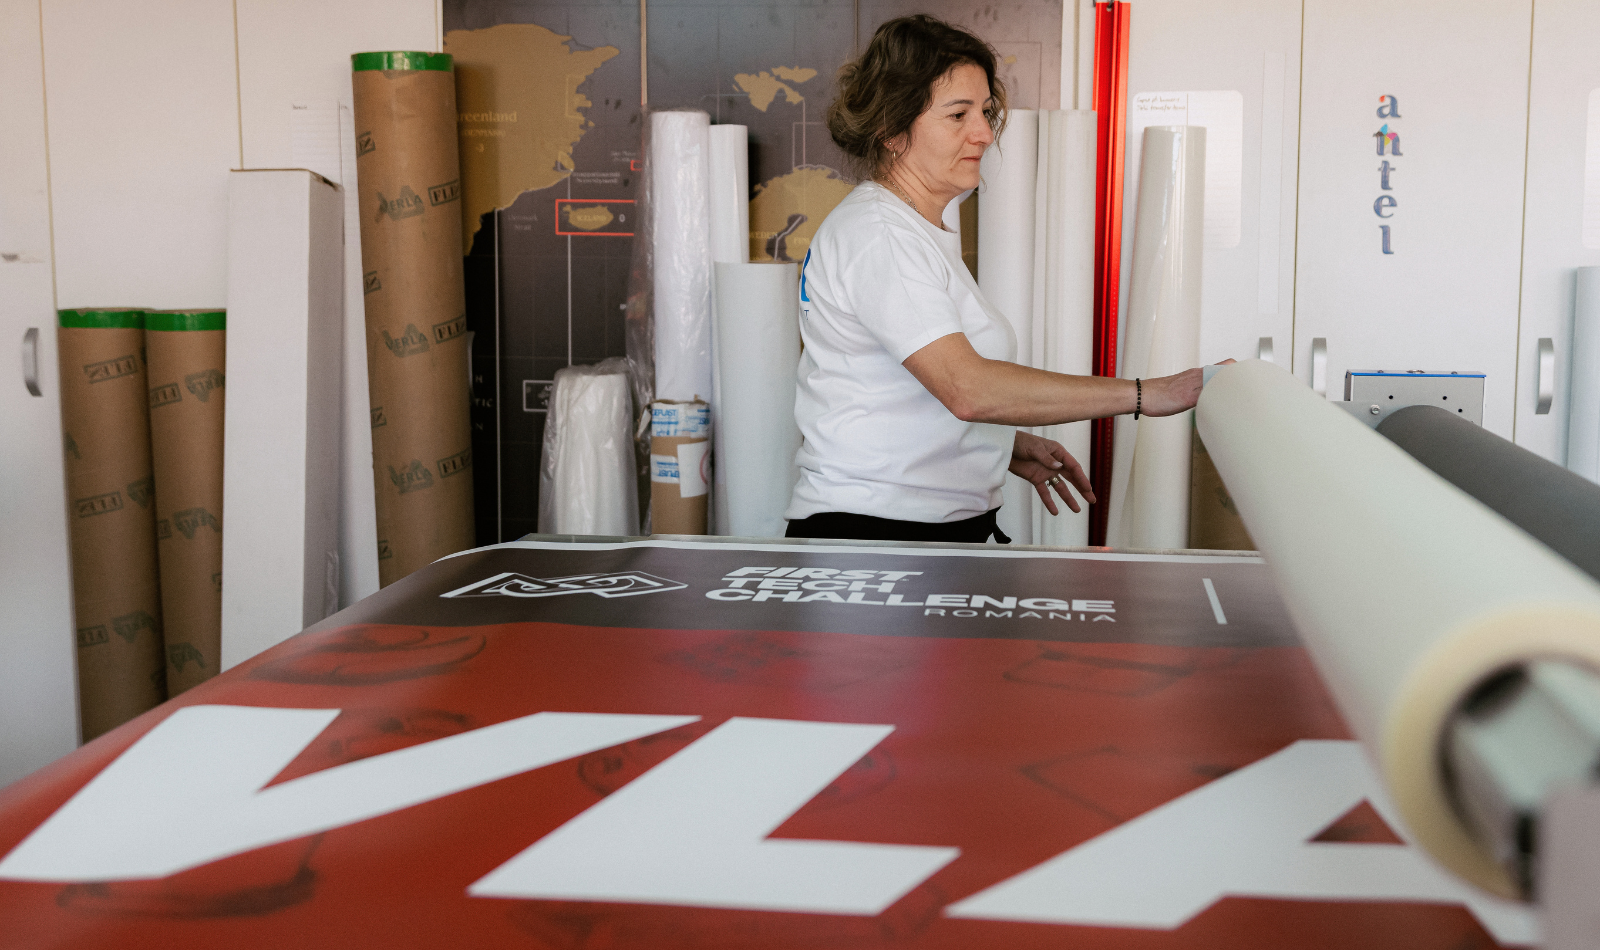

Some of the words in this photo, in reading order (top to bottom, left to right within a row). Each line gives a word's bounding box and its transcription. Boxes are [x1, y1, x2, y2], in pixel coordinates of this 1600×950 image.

[460, 110, 517, 122] reenland
[1372, 94, 1403, 254] antel
[726, 567, 924, 582] FIRST
[721, 578, 896, 593] TECH
[705, 589, 1115, 613] CHALLENGE
[924, 608, 1116, 622] ROMANIA
